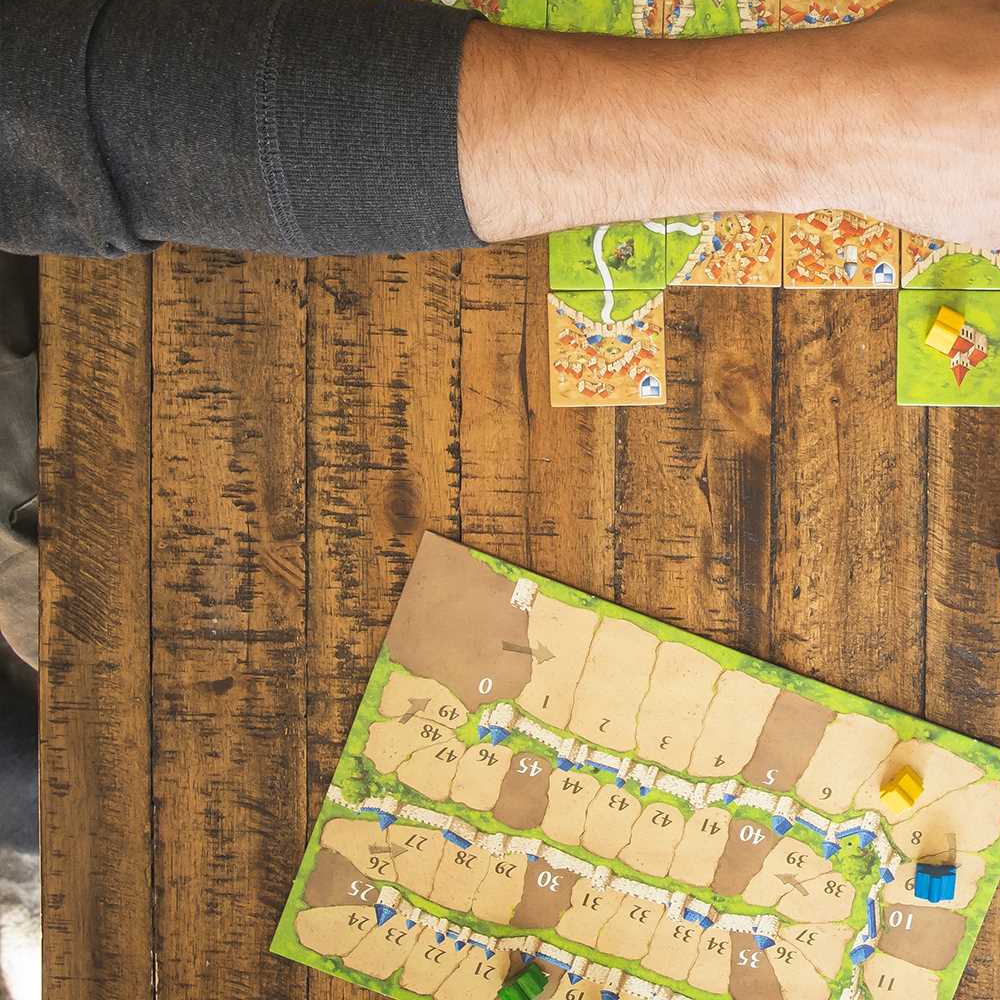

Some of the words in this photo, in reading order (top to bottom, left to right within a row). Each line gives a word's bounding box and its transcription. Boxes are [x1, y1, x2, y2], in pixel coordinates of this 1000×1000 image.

[479, 678, 492, 694] 0
[543, 695, 549, 709] 1
[438, 704, 460, 721] 49
[420, 724, 443, 742] 48
[600, 719, 610, 732] 2
[660, 736, 672, 749] 3
[435, 747, 457, 762] 47
[478, 748, 499, 766] 46
[714, 755, 725, 767] 4
[517, 758, 542, 776] 45
[762, 768, 778, 785] 5
[562, 777, 585, 795] 44
[822, 787, 832, 800] 6
[609, 795, 629, 811] 43
[652, 810, 672, 827] 42
[701, 819, 720, 835] 41
[405, 834, 427, 851] 27
[740, 826, 765, 844] 40
[911, 831, 922, 845] 8
[369, 857, 390, 875] 26
[455, 851, 477, 869] 28
[786, 851, 807, 868] 39
[495, 862, 516, 878] 29
[537, 870, 560, 892] 30
[823, 879, 846, 898] 38
[348, 881, 374, 901] 25
[582, 893, 602, 910] 31
[347, 912, 370, 931] 24
[630, 905, 650, 923] 32
[889, 911, 912, 929] 10
[385, 928, 407, 945] 23
[672, 924, 695, 944] 33
[795, 928, 818, 946] 37
[425, 945, 446, 963] 22
[708, 938, 728, 954] 34
[737, 949, 761, 969] 35
[776, 945, 797, 965] 36
[475, 962, 496, 980] 21
[878, 975, 894, 991] 11
